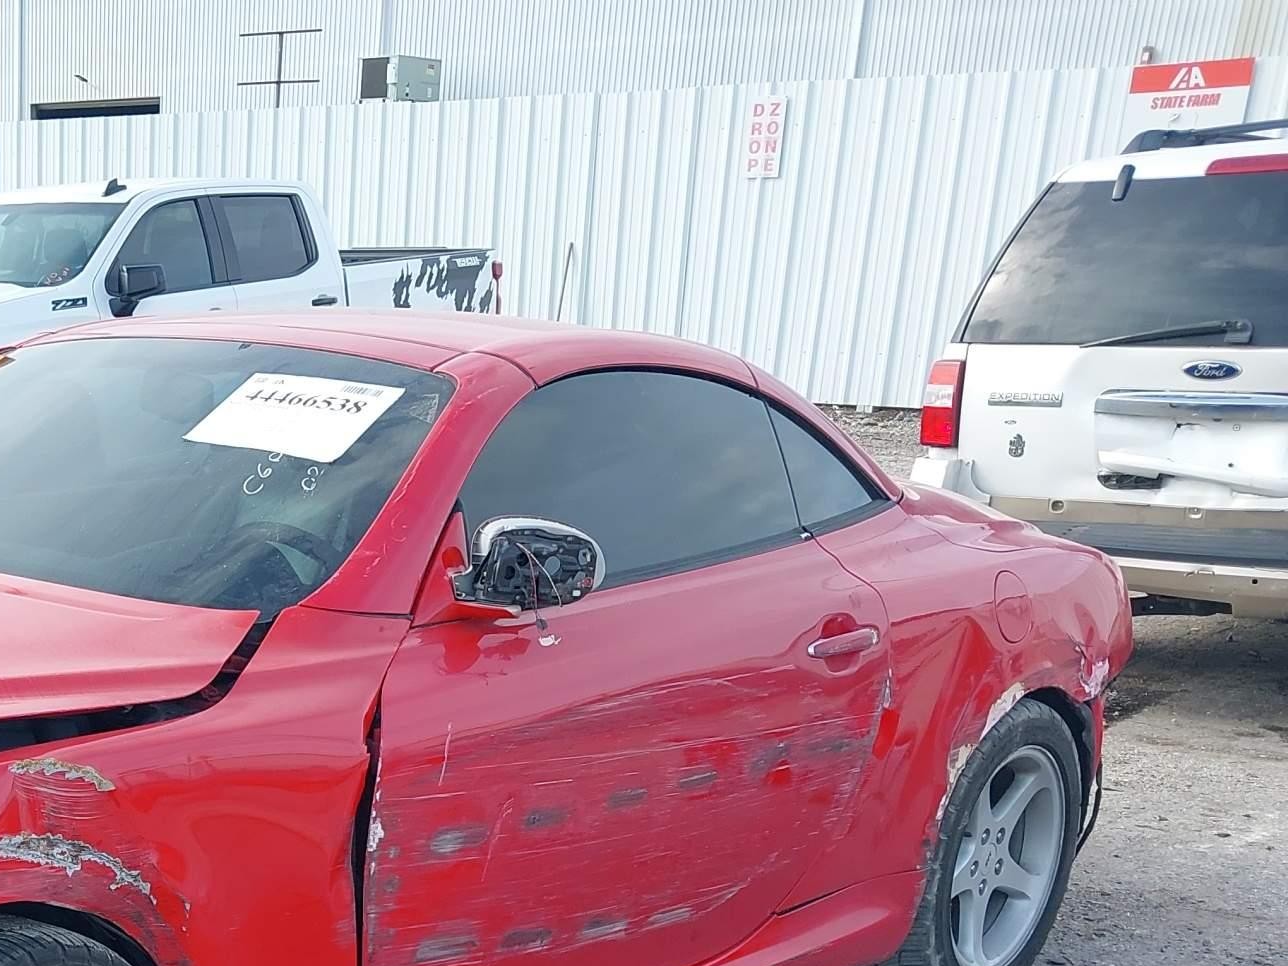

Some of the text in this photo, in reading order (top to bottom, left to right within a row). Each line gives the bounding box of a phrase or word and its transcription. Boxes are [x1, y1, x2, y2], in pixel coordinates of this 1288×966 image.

[1151, 93, 1221, 110] STATE FARM
[1194, 363, 1227, 376] Ford
[244, 389, 368, 415] 44466538
[989, 391, 1062, 401] EXPEDITION
